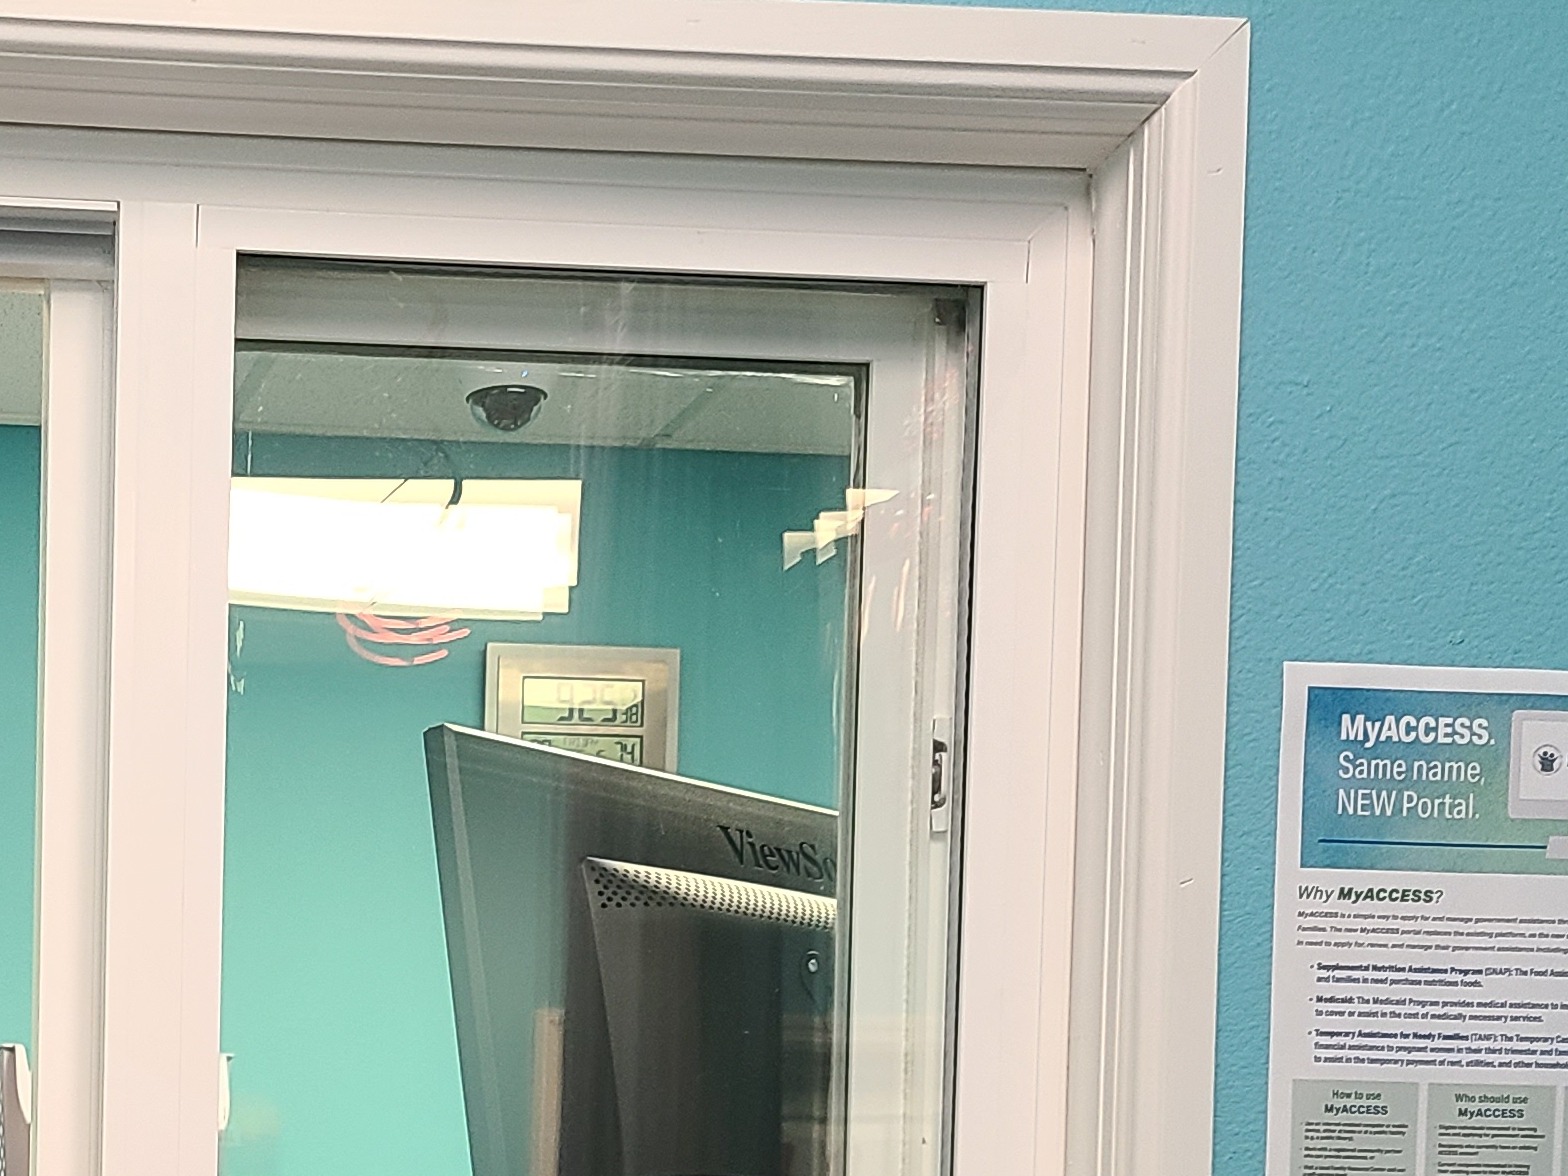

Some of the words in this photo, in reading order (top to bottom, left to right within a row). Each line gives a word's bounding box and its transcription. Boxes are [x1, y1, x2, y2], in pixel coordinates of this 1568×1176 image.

[1338, 750, 1407, 780] Same
[1337, 788, 1397, 816] NEW
[1298, 884, 1335, 904] Why
[1336, 886, 1444, 905] MyACCESS?
[1331, 1089, 1353, 1100] How
[1353, 1090, 1364, 1100] to
[1365, 1092, 1382, 1101] use
[1454, 1092, 1477, 1103] Who
[1477, 1093, 1511, 1104] should
[1511, 1096, 1530, 1105] use
[1323, 1103, 1389, 1117] MyACCESS
[1457, 1107, 1525, 1120] MyACCESS
